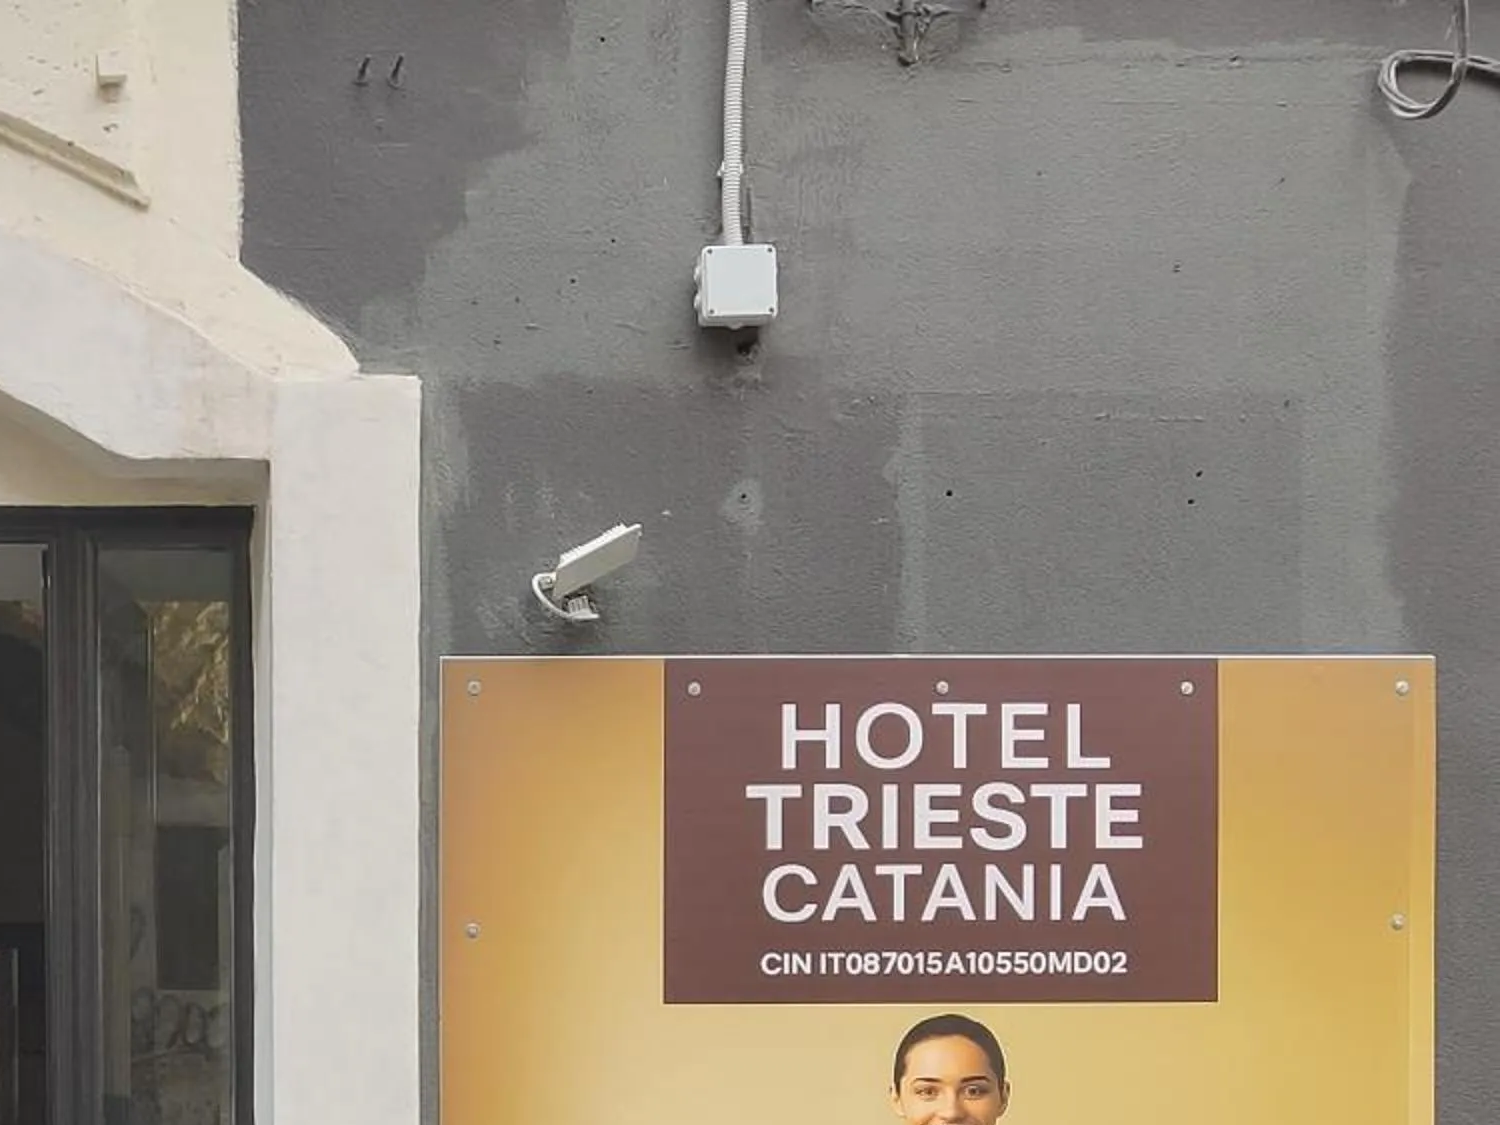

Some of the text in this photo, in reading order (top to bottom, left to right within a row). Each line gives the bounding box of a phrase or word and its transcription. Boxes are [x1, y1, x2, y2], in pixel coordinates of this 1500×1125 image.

[780, 702, 1112, 770] HOTEL
[744, 781, 1144, 851] TRIESTE
[761, 863, 1127, 923] CATANIA
[760, 950, 1129, 976] CIN IT087015A10550MD02
